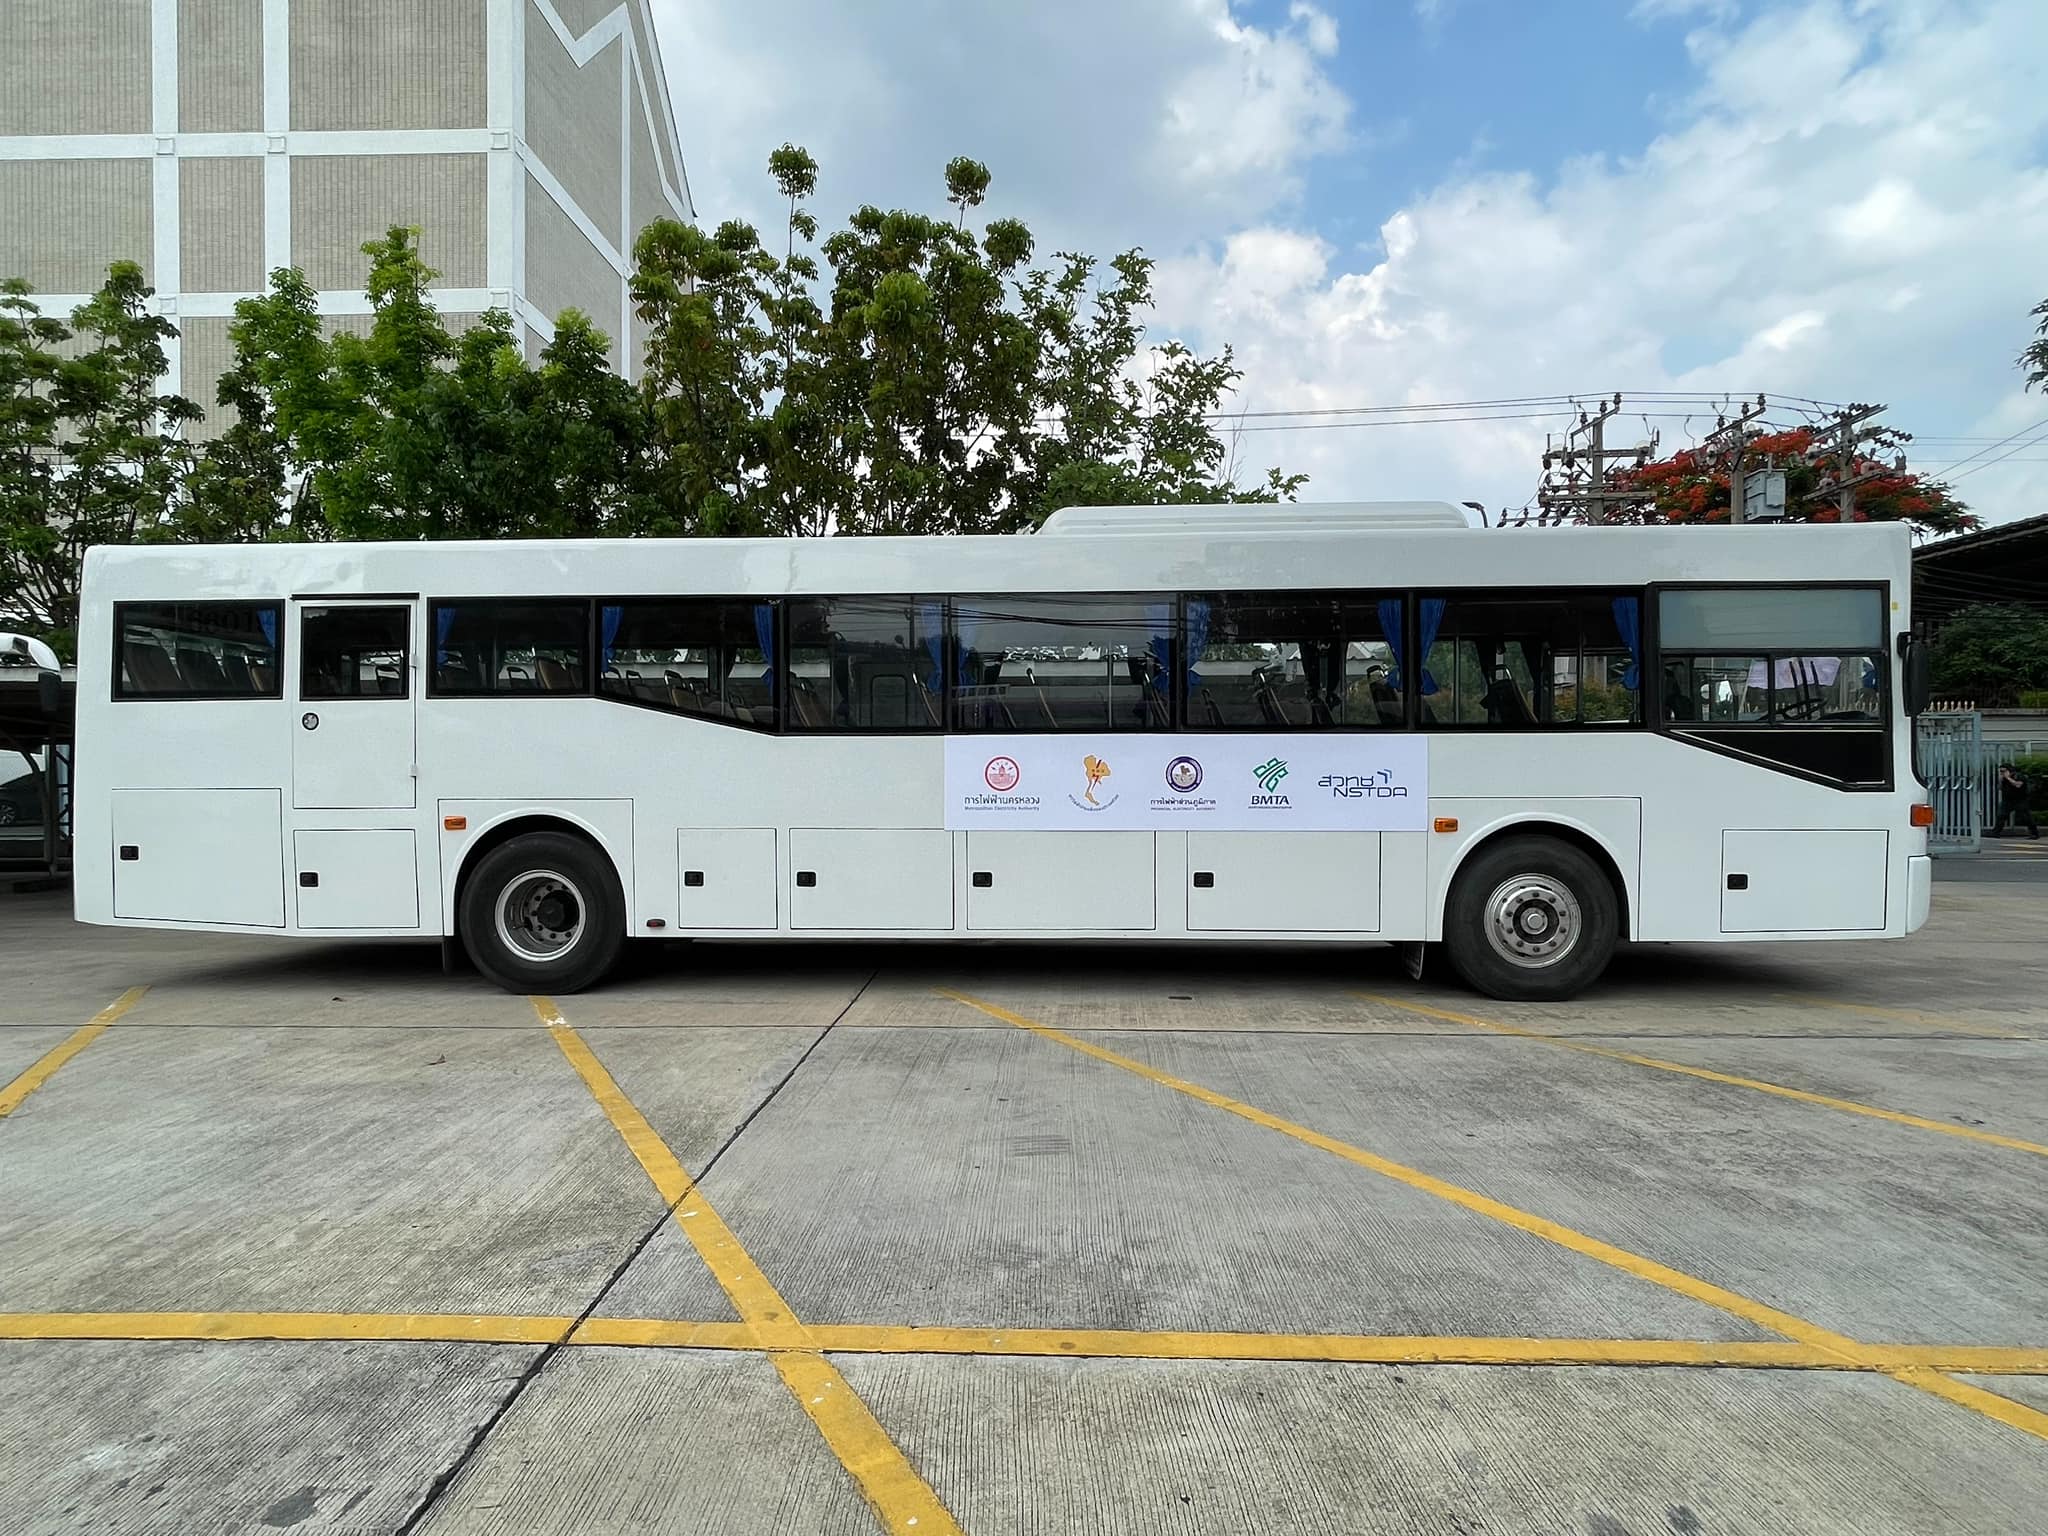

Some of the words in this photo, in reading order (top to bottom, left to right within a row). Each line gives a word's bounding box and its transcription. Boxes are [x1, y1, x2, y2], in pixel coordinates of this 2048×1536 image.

[1318, 774, 1374, 787] สวทช
[1333, 787, 1408, 798] NSTDA
[1251, 795, 1290, 805] BMTA
